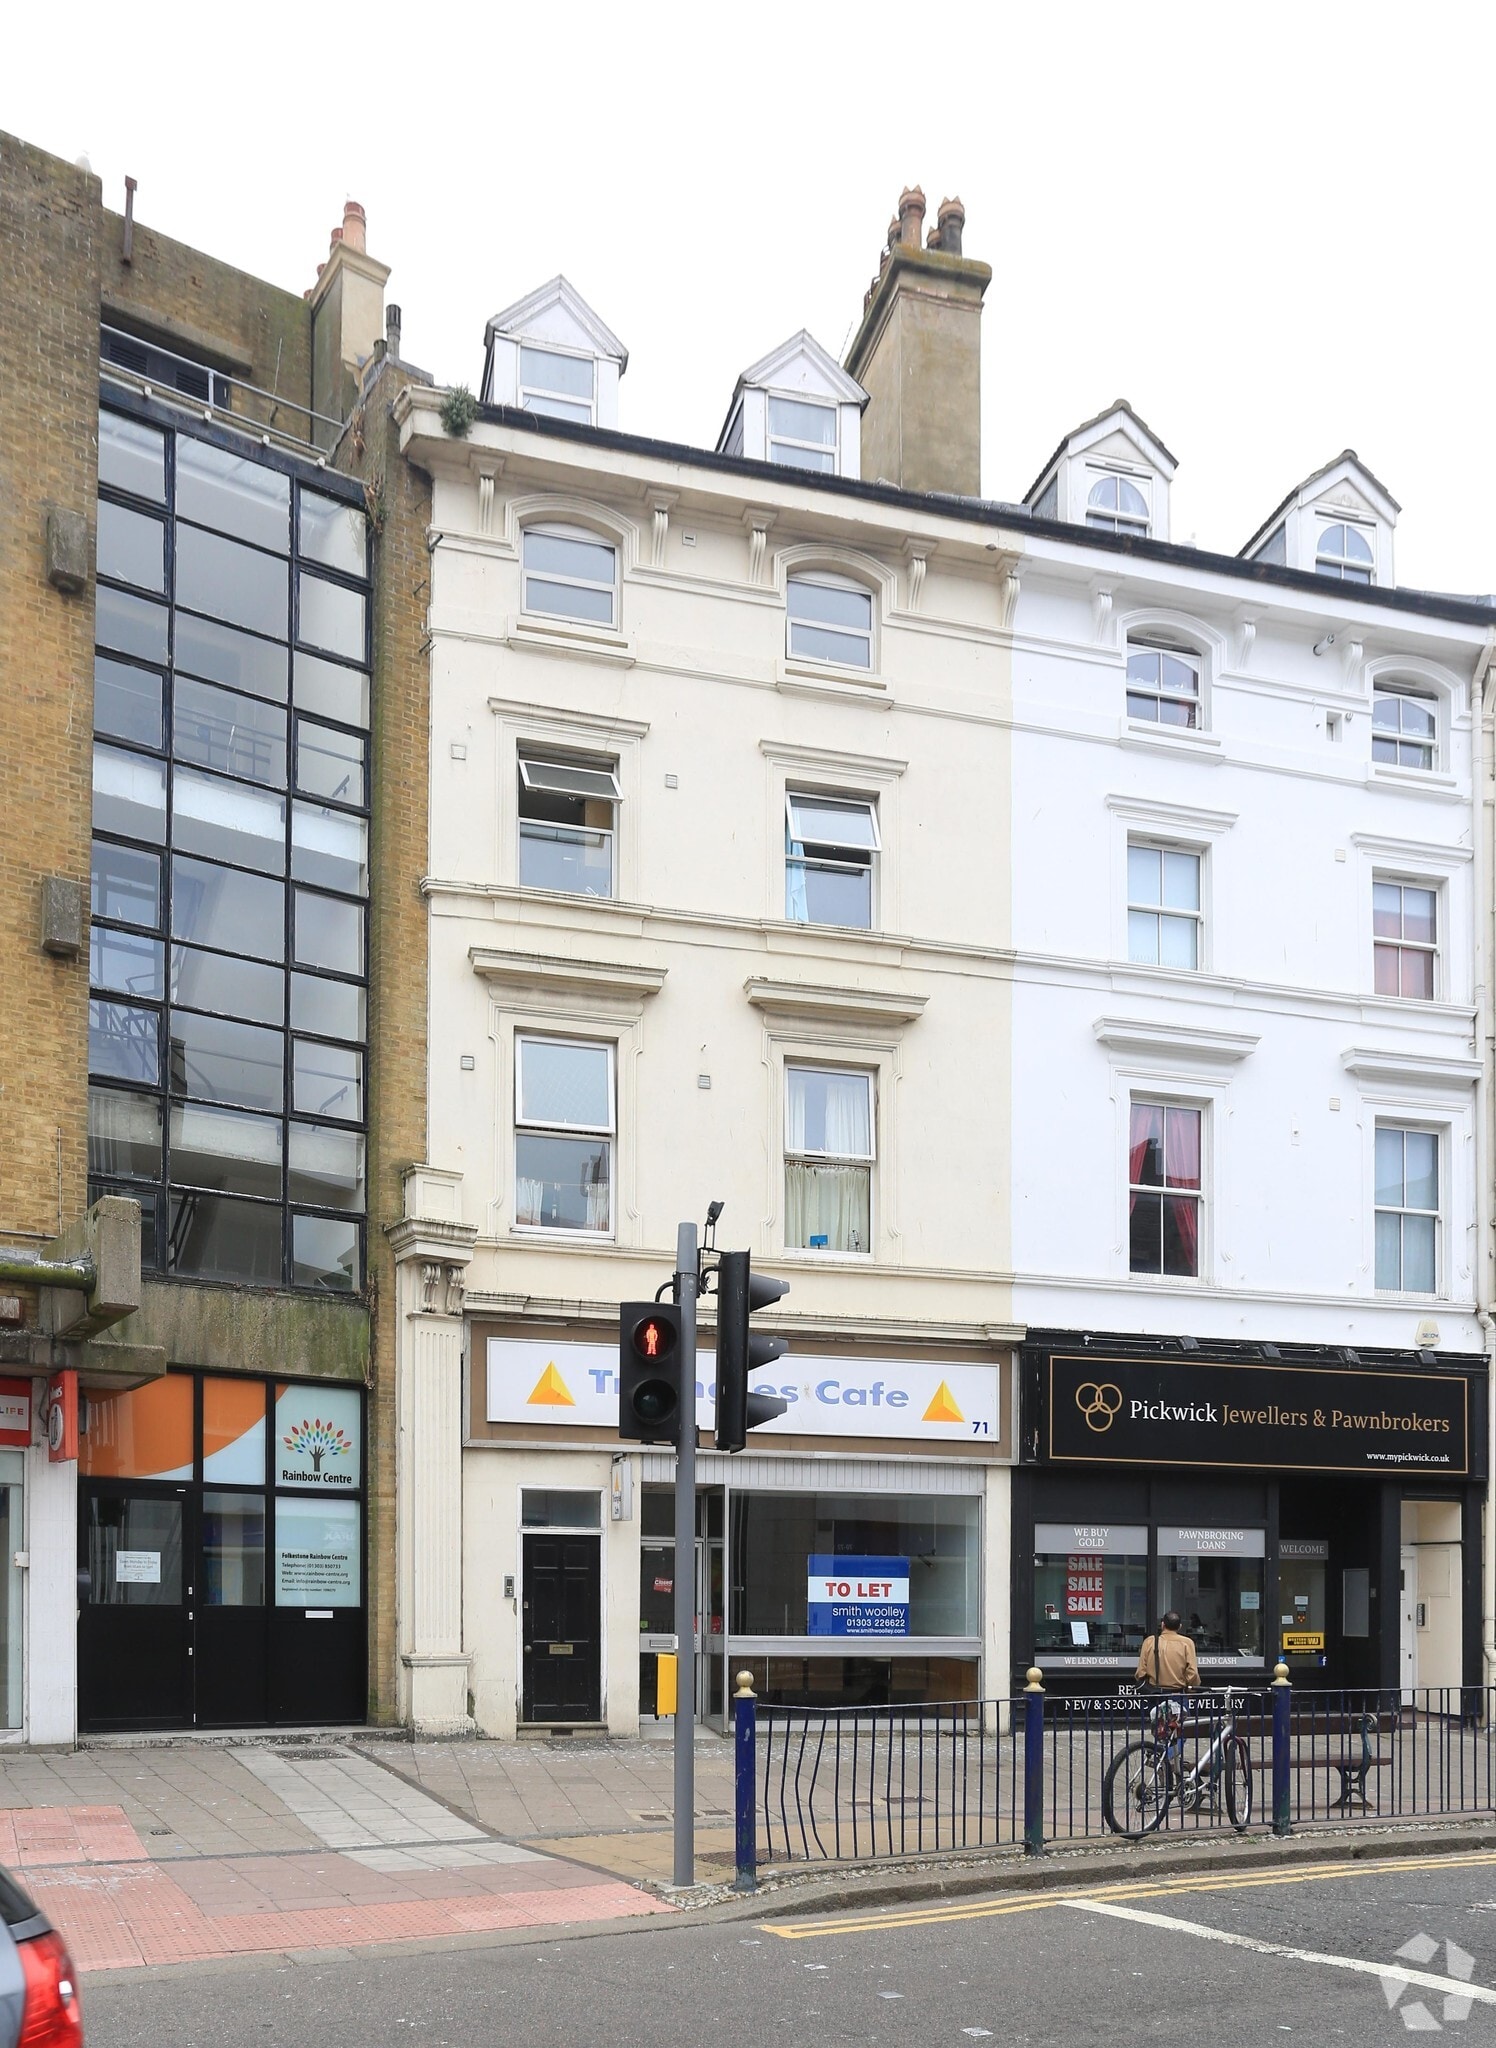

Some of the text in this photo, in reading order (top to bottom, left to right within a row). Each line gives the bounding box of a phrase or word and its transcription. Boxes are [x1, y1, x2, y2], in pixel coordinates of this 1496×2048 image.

[815, 1380, 909, 1408] Cafe
[1130, 1400, 1450, 1433] Pickwick Jewellers & Pawnbrokers
[972, 1421, 989, 1434] 71
[1366, 1453, 1450, 1463] www.mypickwick.co.uk
[282, 1470, 352, 1484] Rainbow Centre
[1074, 1527, 1109, 1537] WE BUY
[1178, 1530, 1244, 1541] PAWNBROKING
[1078, 1538, 1105, 1547] GOLD
[1197, 1540, 1226, 1550] LOANS
[1280, 1544, 1325, 1554] WELCOME
[1068, 1557, 1103, 1571] SALE
[1068, 1577, 1103, 1591] SALE
[825, 1583, 892, 1597] TO LET
[1068, 1597, 1103, 1611] SALE
[832, 1606, 905, 1618] smith woolley
[846, 1619, 905, 1627] 01303 226622
[1064, 1657, 1119, 1665] WE LEND CASH
[1198, 1657, 1237, 1665] LEND CASH
